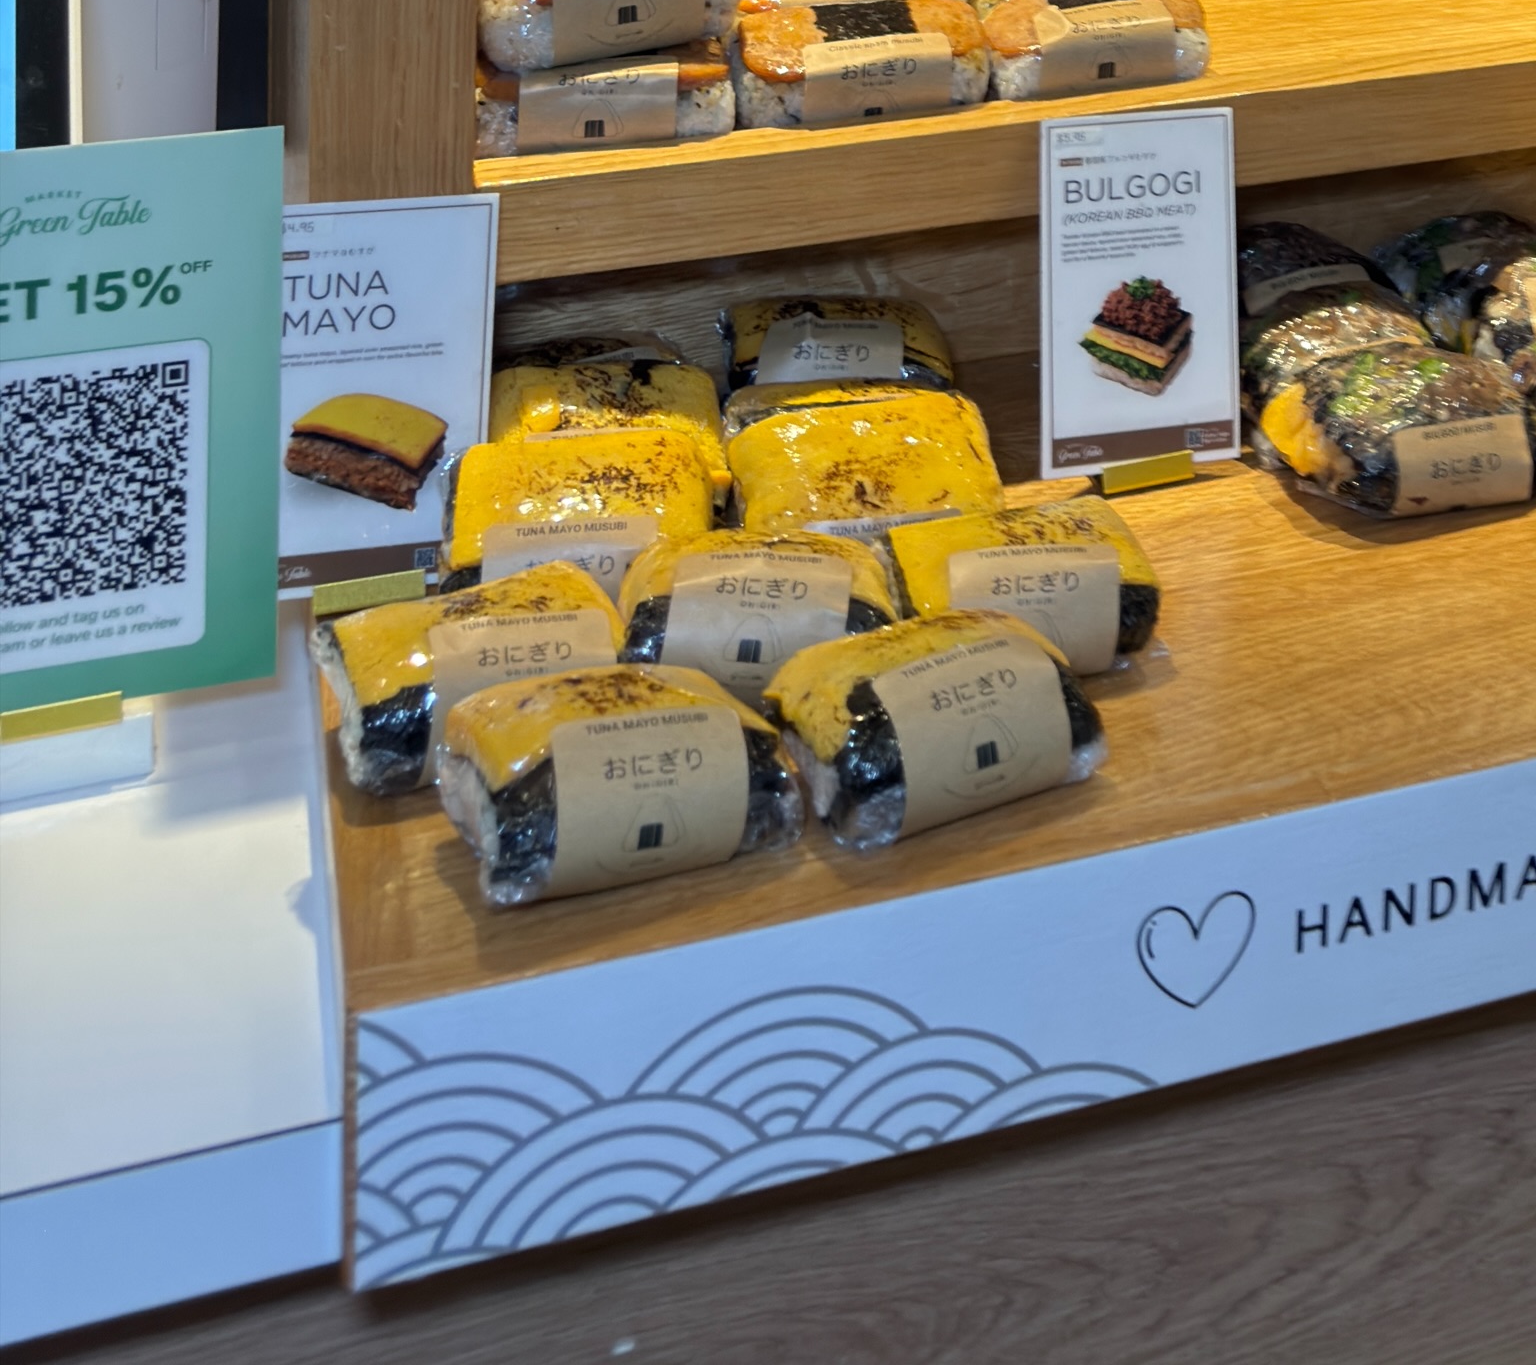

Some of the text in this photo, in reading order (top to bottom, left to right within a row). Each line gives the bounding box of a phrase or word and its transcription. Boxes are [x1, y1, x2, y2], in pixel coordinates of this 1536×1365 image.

[841, 58, 917, 80] おにぎり
[1064, 169, 1201, 204] BULGOGI
[0, 194, 152, 247] Green Table
[1063, 204, 1196, 226] (KOREAN BBQ MEAT)
[67, 265, 182, 315] 15%
[180, 260, 213, 274] OFF
[284, 270, 389, 302] TUNA
[282, 304, 396, 338] MAYO
[792, 343, 870, 362] おにぎり
[516, 522, 628, 538] TUNA MAYO MUSUBI
[829, 526, 859, 536] TUNA
[715, 576, 808, 600] おにぎり
[991, 571, 1080, 596] おにぎり
[38, 613, 69, 629] and
[73, 610, 99, 625] tag
[102, 608, 120, 619] us
[124, 604, 146, 616] on
[461, 613, 578, 632] TUNA MAYO MUSUBI
[29, 637, 47, 649] or
[50, 630, 91, 646] leave
[95, 627, 114, 638] us
[117, 625, 128, 636] a
[130, 616, 182, 633] review
[477, 641, 572, 667] おにぎり
[902, 639, 1009, 680] TUNA MAYO MUSUBI
[930, 669, 1017, 712] おにぎり
[586, 713, 708, 736] TUNA MAYO MUSUBI
[603, 747, 702, 780] おにぎり
